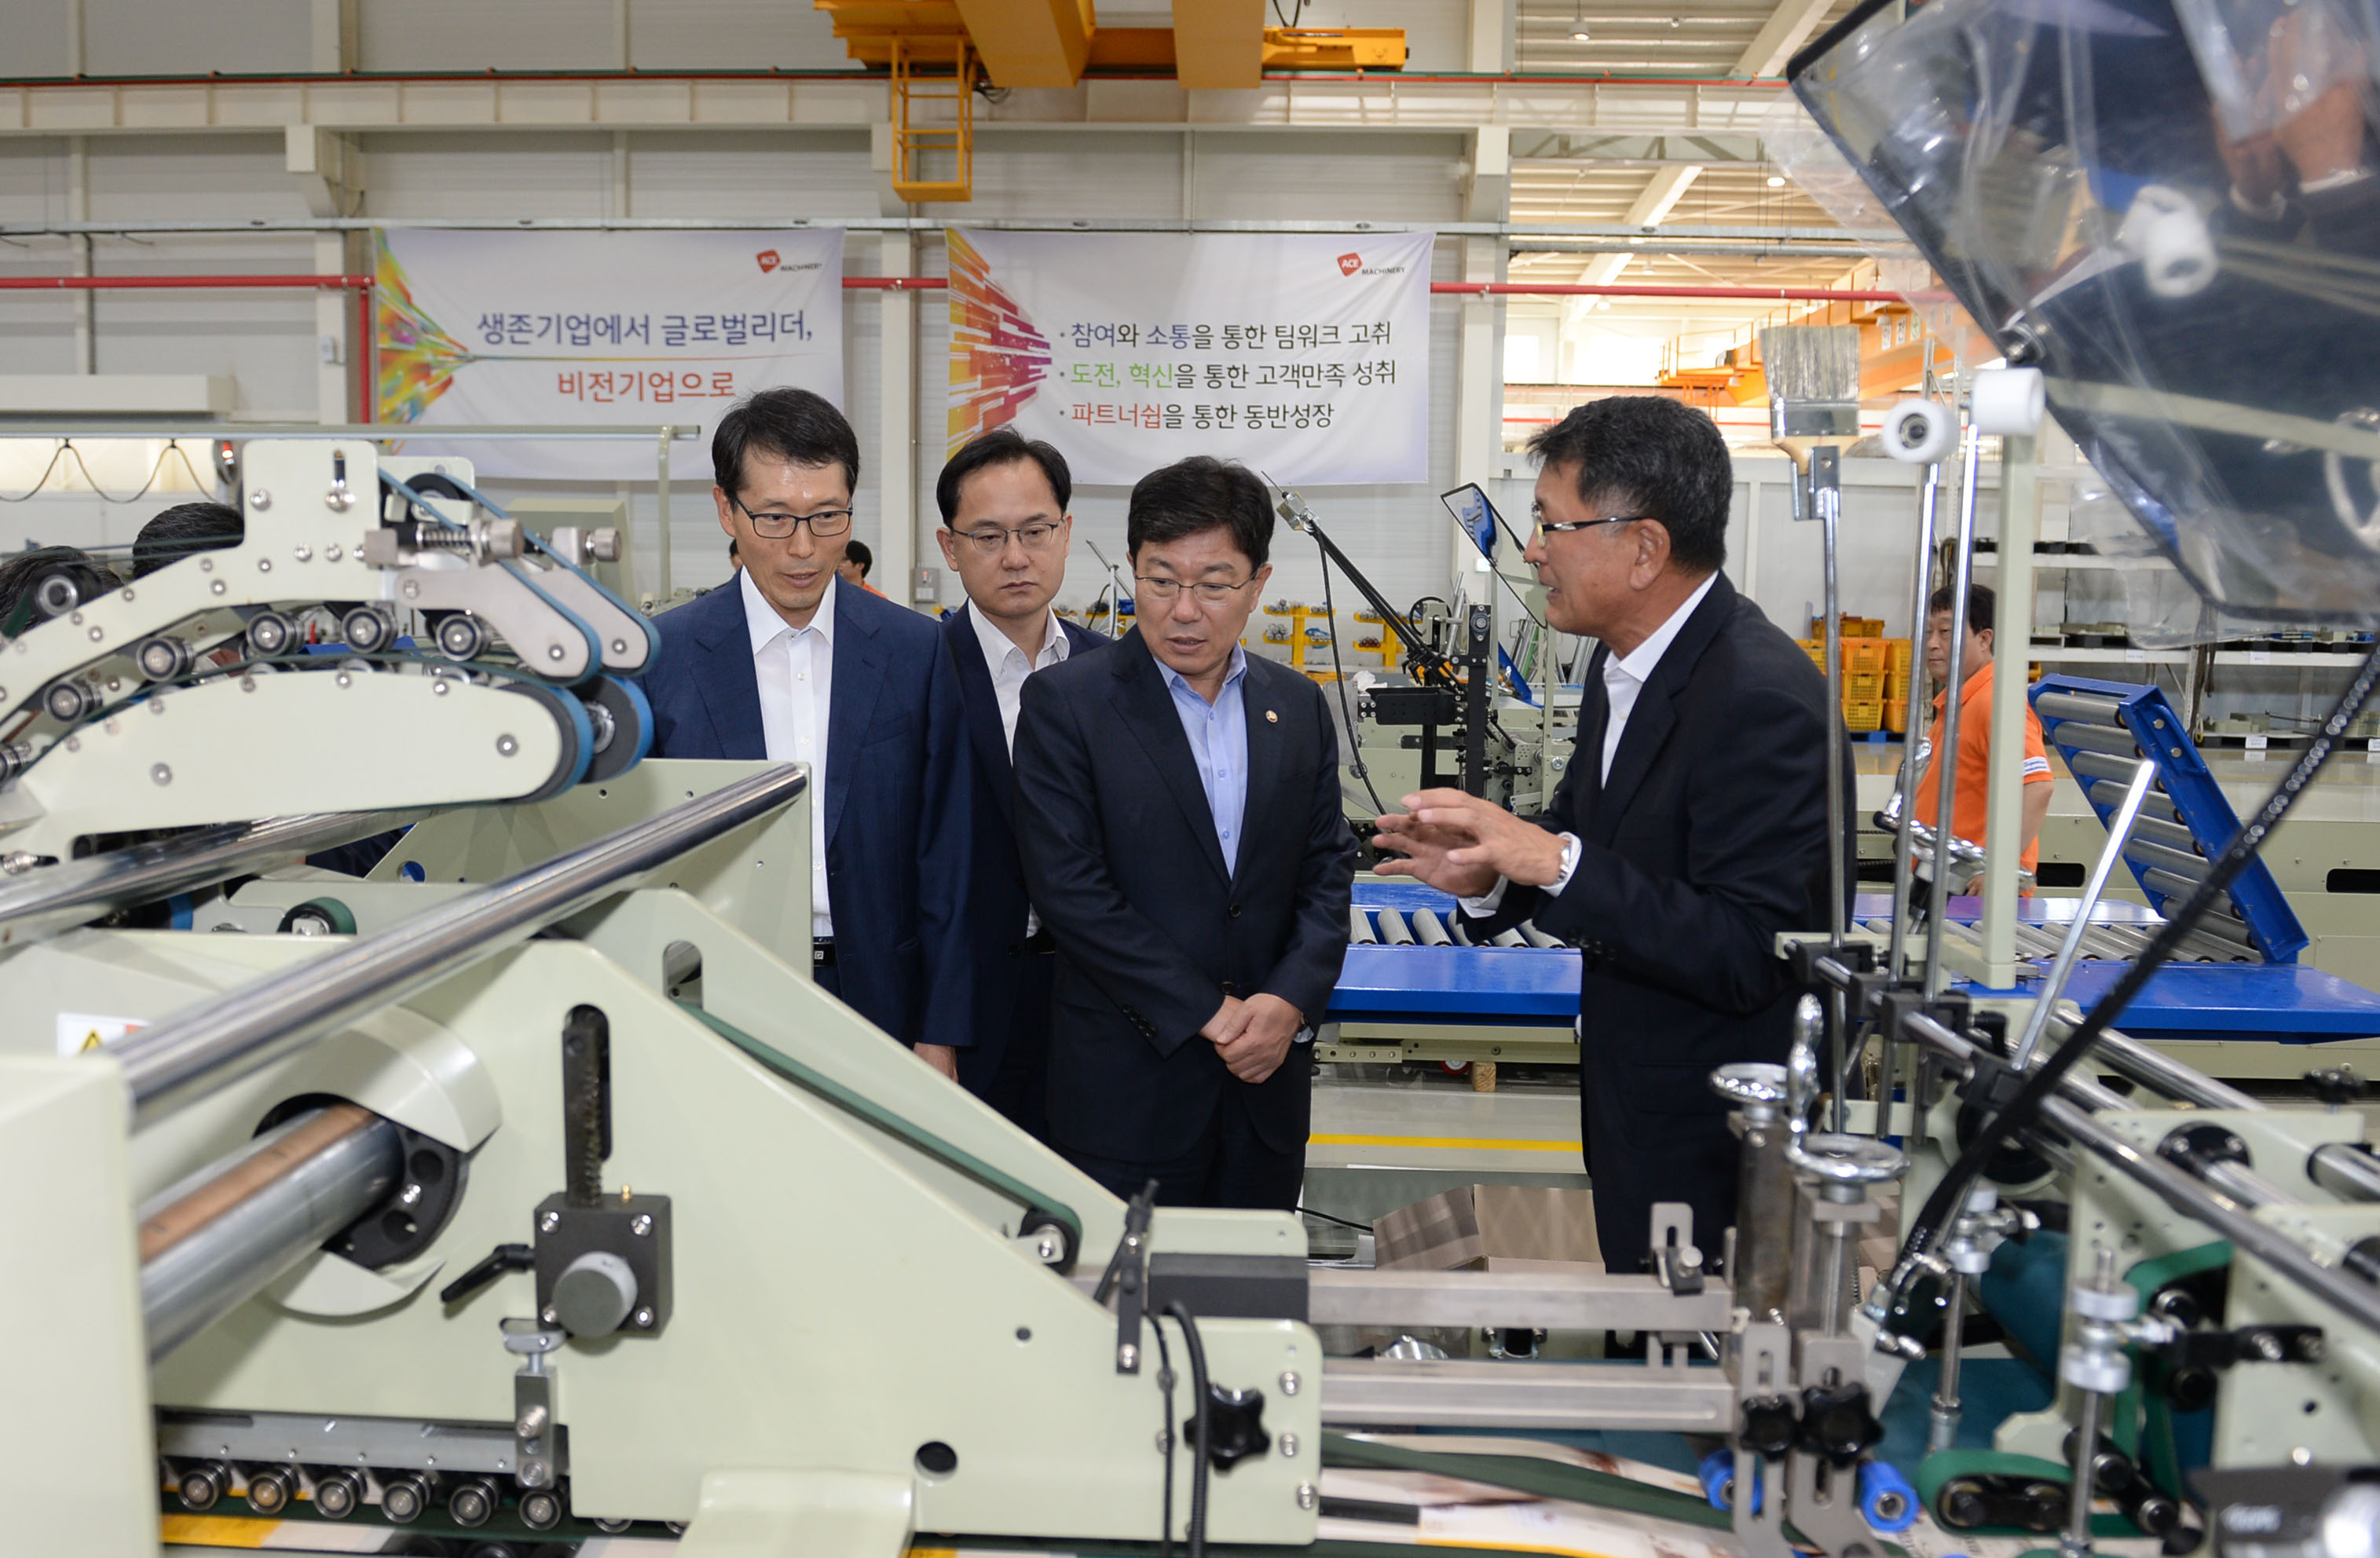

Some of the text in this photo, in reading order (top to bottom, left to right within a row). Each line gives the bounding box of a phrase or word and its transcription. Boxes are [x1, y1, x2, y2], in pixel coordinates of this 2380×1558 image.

[1341, 258, 1360, 269] ACE
[1361, 266, 1405, 276] MACHINERY
[477, 309, 812, 346] 생존기업에서 글로벌리더,
[1071, 320, 1390, 350] 참여와 소통을 통한 팀워크 고취
[558, 371, 736, 403] 비전기업으로
[1071, 359, 1396, 390] 도전, 혁신을 통한 고객만족 성취
[1071, 401, 1335, 430] 파트너쉽을 통한 동반성장
